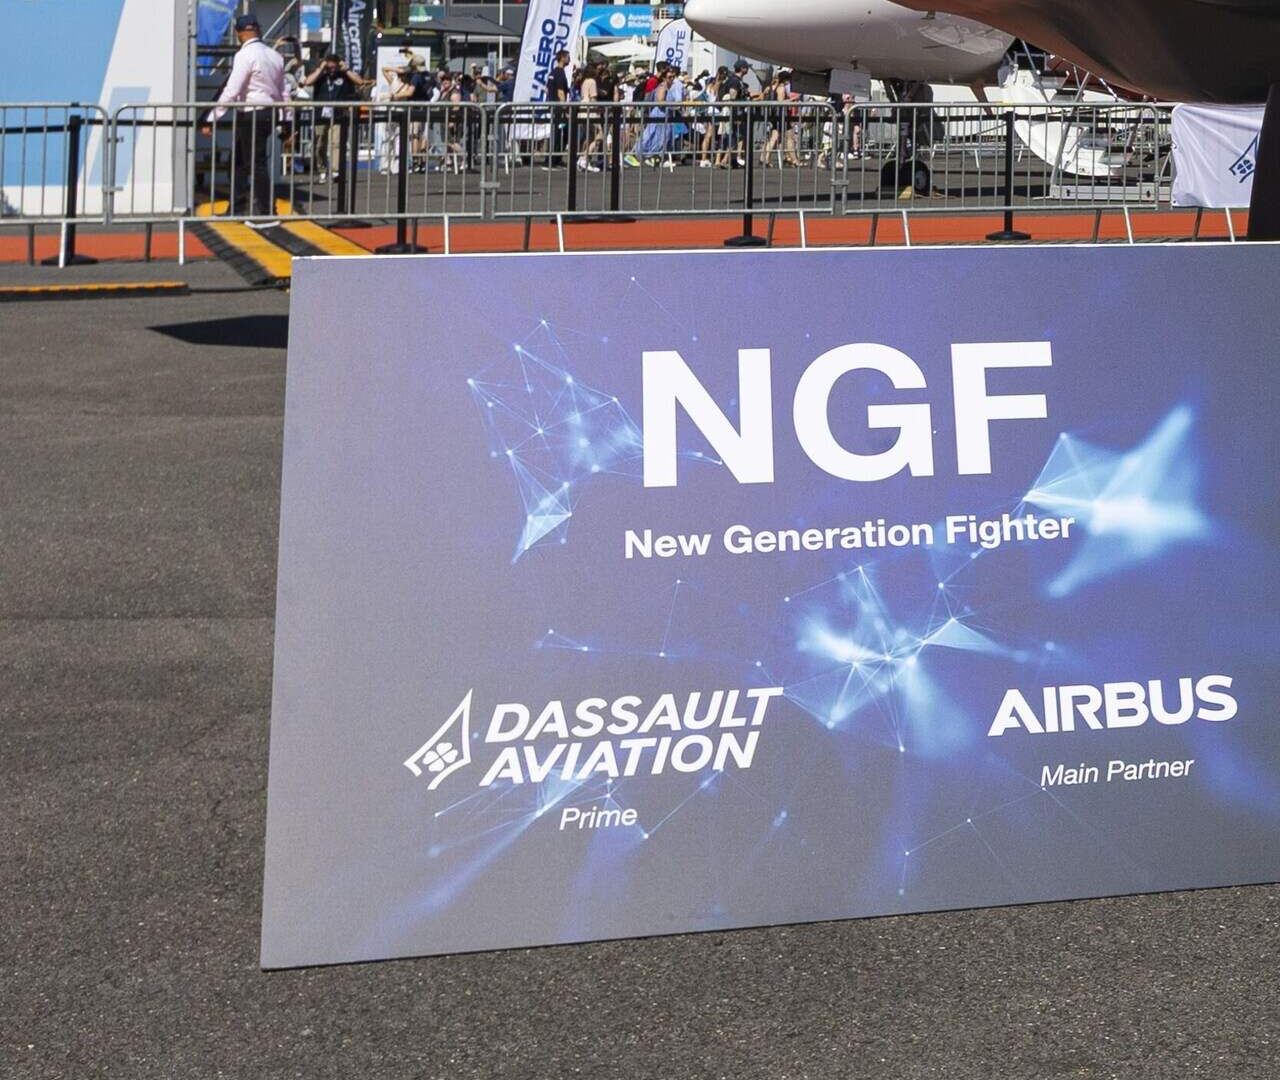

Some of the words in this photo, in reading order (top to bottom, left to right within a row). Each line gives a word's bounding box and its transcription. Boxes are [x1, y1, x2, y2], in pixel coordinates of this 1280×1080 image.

[529, 18, 557, 102] L'AÉRO
[641, 340, 1053, 488] NGF
[624, 529, 712, 559] New
[723, 518, 934, 554] Generation
[945, 513, 1075, 550] Fighter
[484, 687, 784, 744] DASSAULT
[987, 674, 1238, 737] AIRBUS
[479, 731, 760, 787] AVIATION
[1040, 762, 1099, 787] Main
[1106, 758, 1195, 783] Partner
[559, 806, 638, 831] Prime
